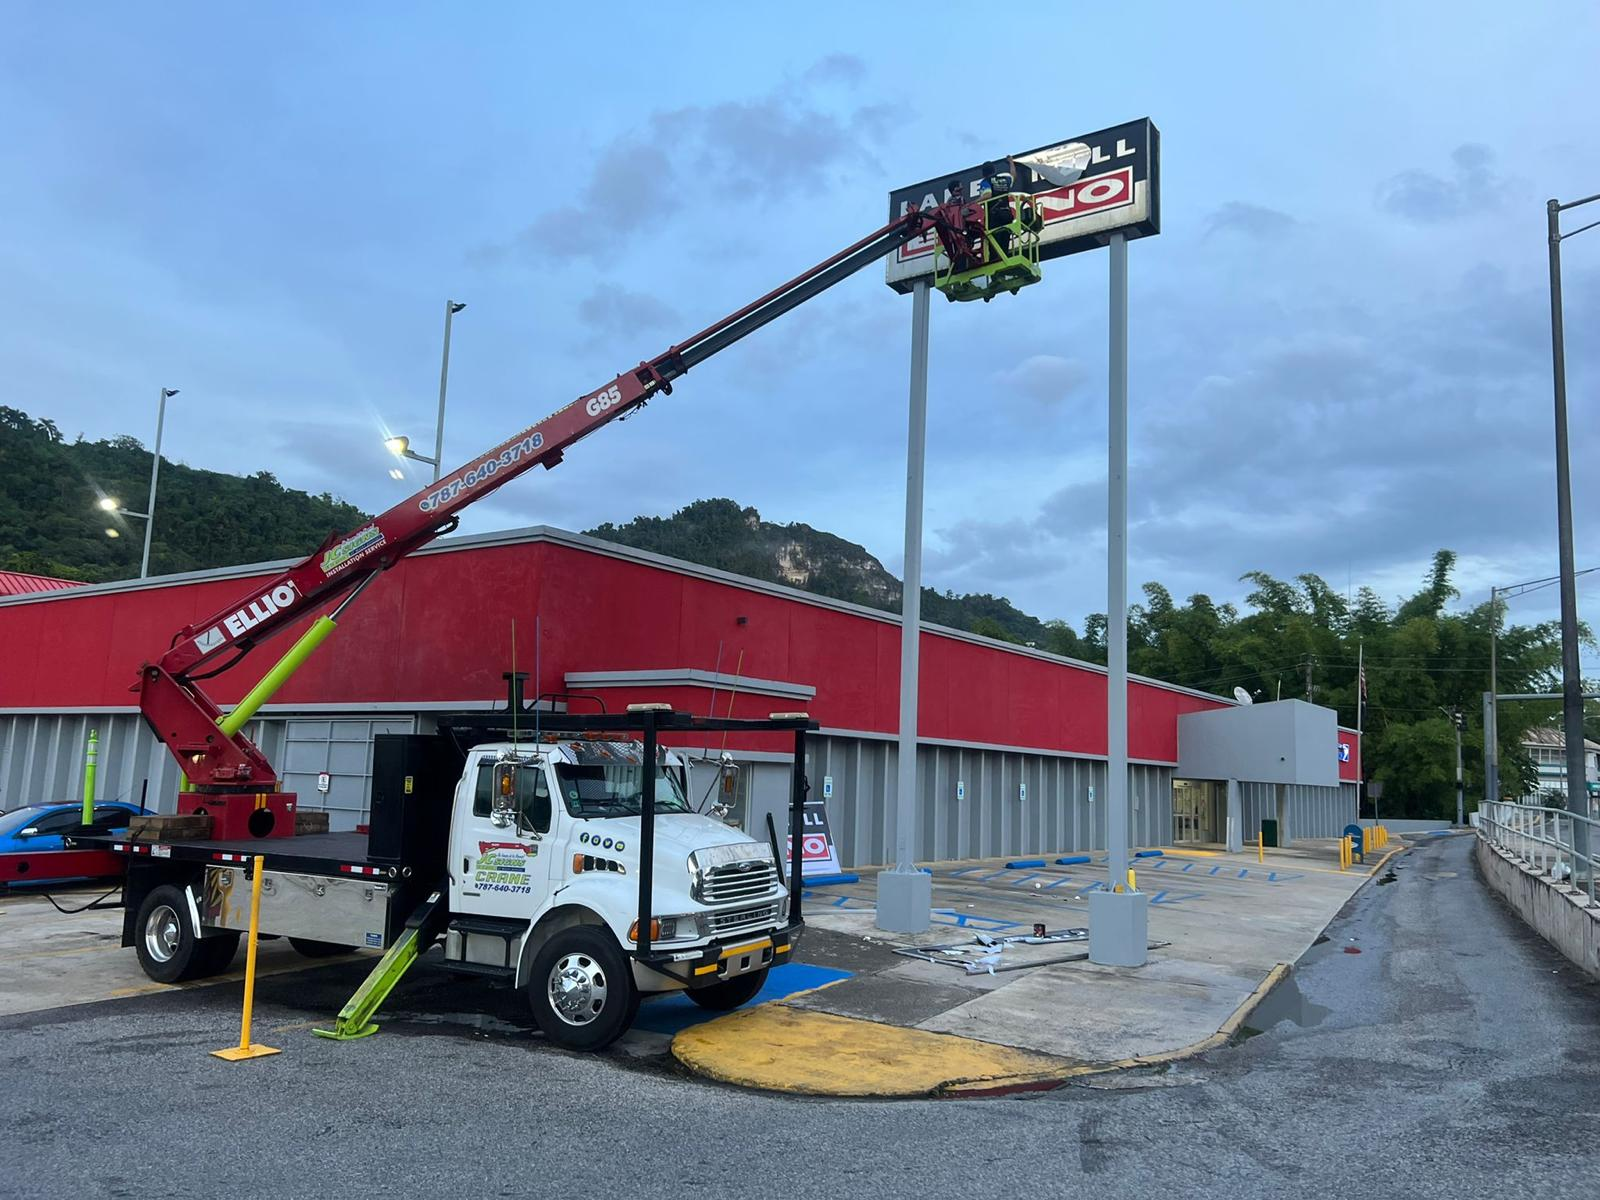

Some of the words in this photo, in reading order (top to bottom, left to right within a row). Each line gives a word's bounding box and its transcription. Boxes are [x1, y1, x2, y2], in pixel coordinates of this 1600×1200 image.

[586, 384, 622, 418] G85
[429, 431, 544, 510] 787-640-3718
[325, 552, 365, 578] INSTALLATION
[364, 538, 387, 555] SERVICE
[475, 871, 531, 885] CRANE
[478, 883, 531, 893] 787-640-3718
